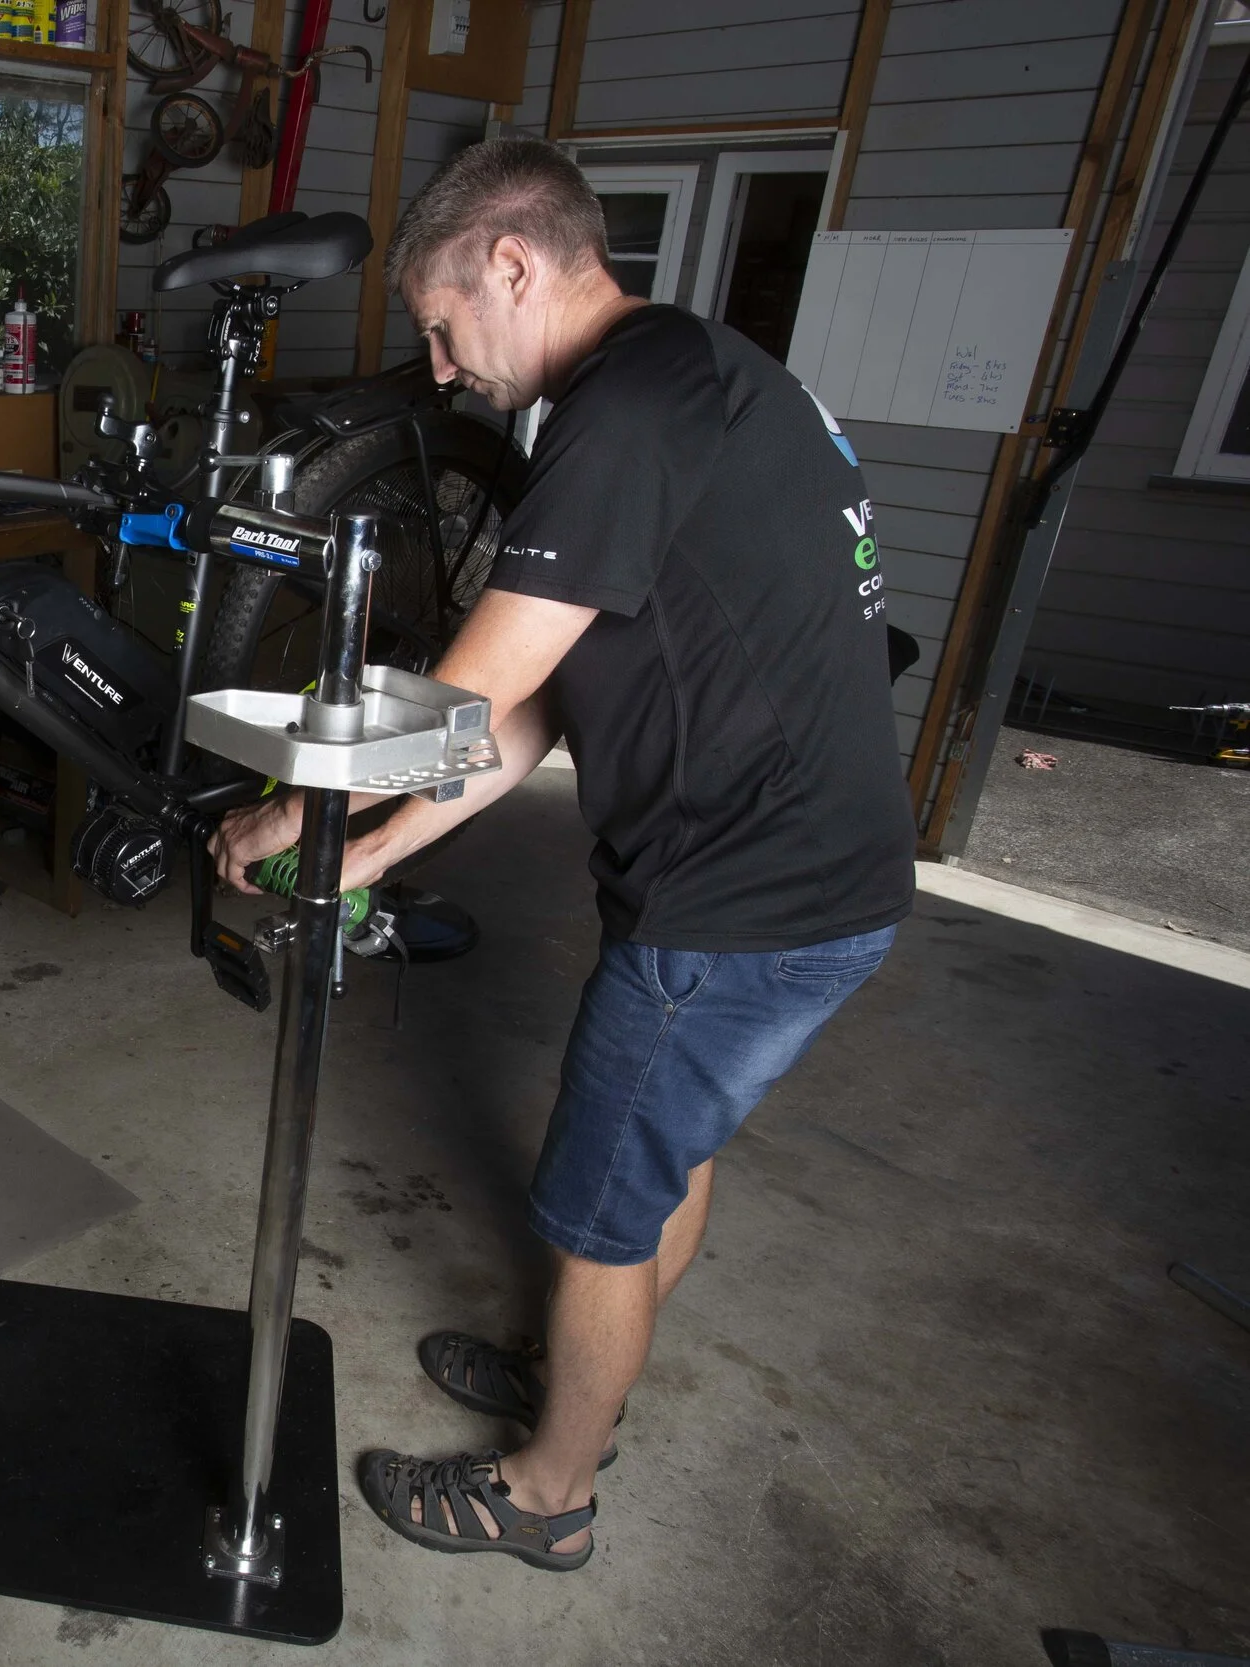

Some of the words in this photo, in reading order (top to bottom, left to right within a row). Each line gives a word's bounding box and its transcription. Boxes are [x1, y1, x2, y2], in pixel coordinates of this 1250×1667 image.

[60, 2, 86, 21] Wipes
[231, 526, 267, 544] Park
[266, 533, 300, 552] Tool
[503, 545, 558, 560] ELITE
[864, 597, 885, 620] SPE
[61, 643, 124, 705] VENTURE
[120, 839, 162, 870] VENTURE
